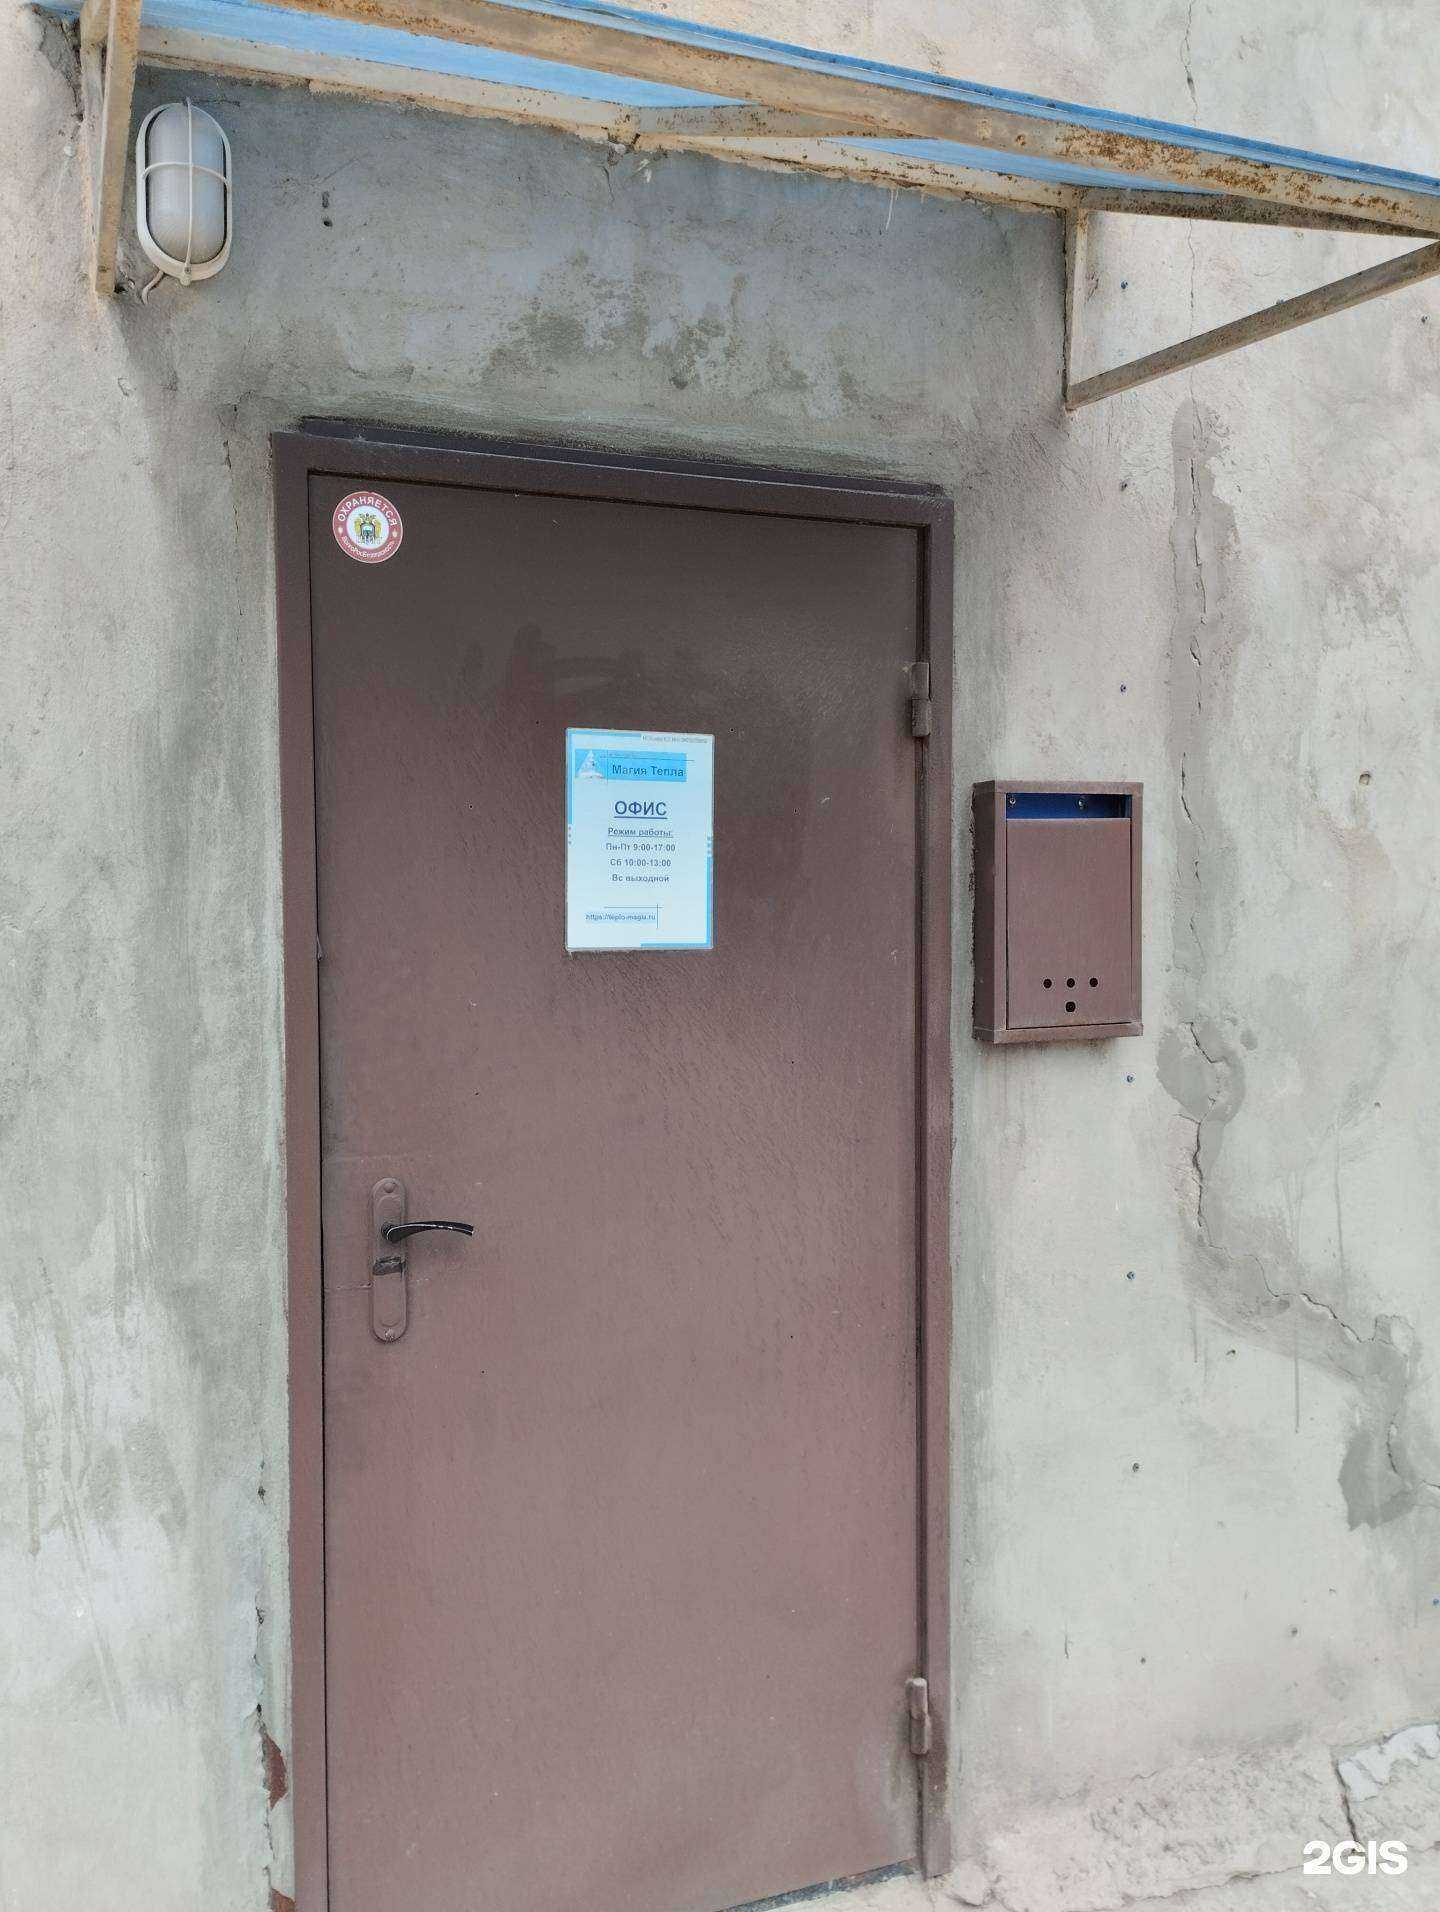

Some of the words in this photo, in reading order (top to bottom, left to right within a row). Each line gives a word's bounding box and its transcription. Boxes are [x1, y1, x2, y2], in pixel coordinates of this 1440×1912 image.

[337, 496, 398, 526] ОХРАНЯЕТСЯ
[612, 764, 647, 776] Магия
[650, 765, 684, 777] Тепла
[614, 800, 667, 816] ОФИС
[607, 827, 636, 836] Режим
[638, 828, 673, 838] работы:
[605, 843, 631, 851] Пн-Пт
[610, 858, 622, 867] Сб
[625, 859, 672, 867] 10:00-13:00
[611, 873, 623, 882] Вс
[625, 874, 670, 883] выходной
